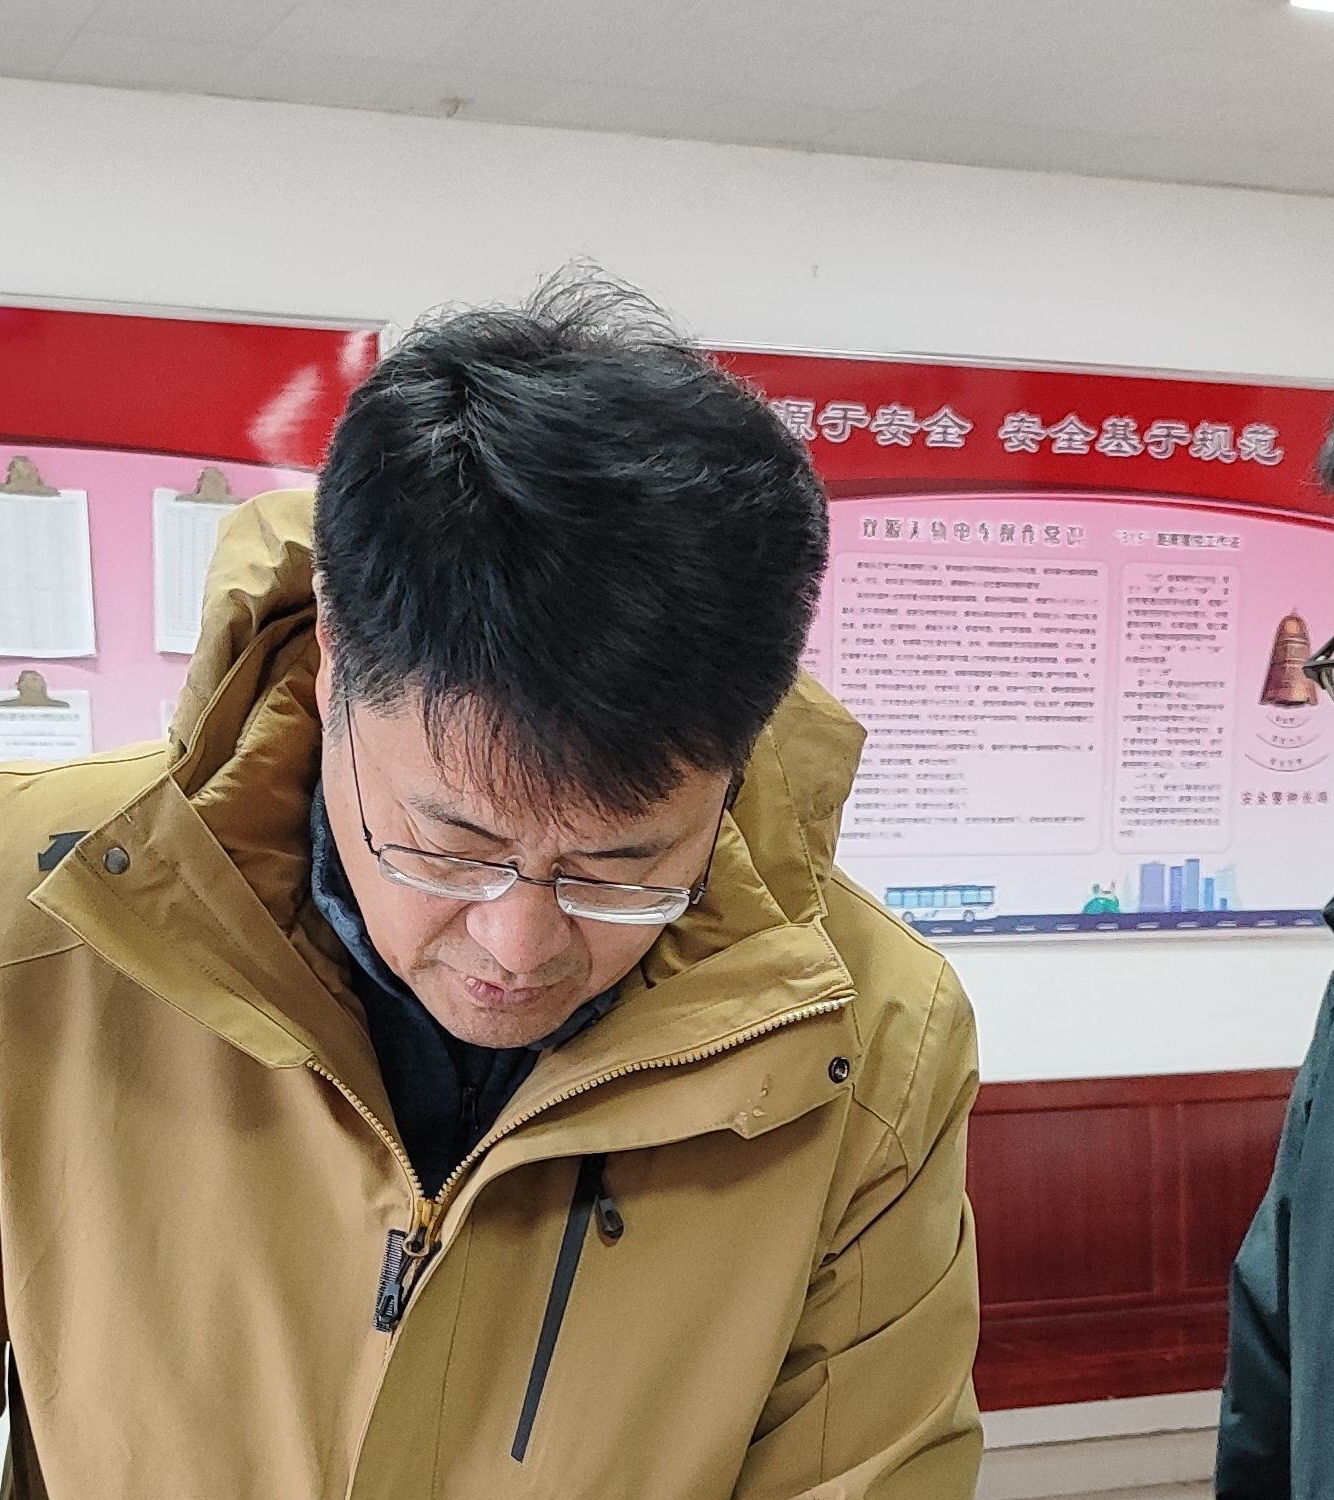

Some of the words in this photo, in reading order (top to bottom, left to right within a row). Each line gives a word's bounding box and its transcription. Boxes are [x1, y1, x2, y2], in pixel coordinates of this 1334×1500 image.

[770, 399, 974, 448] 源于安全
[998, 411, 1285, 466] 安全基于规范
